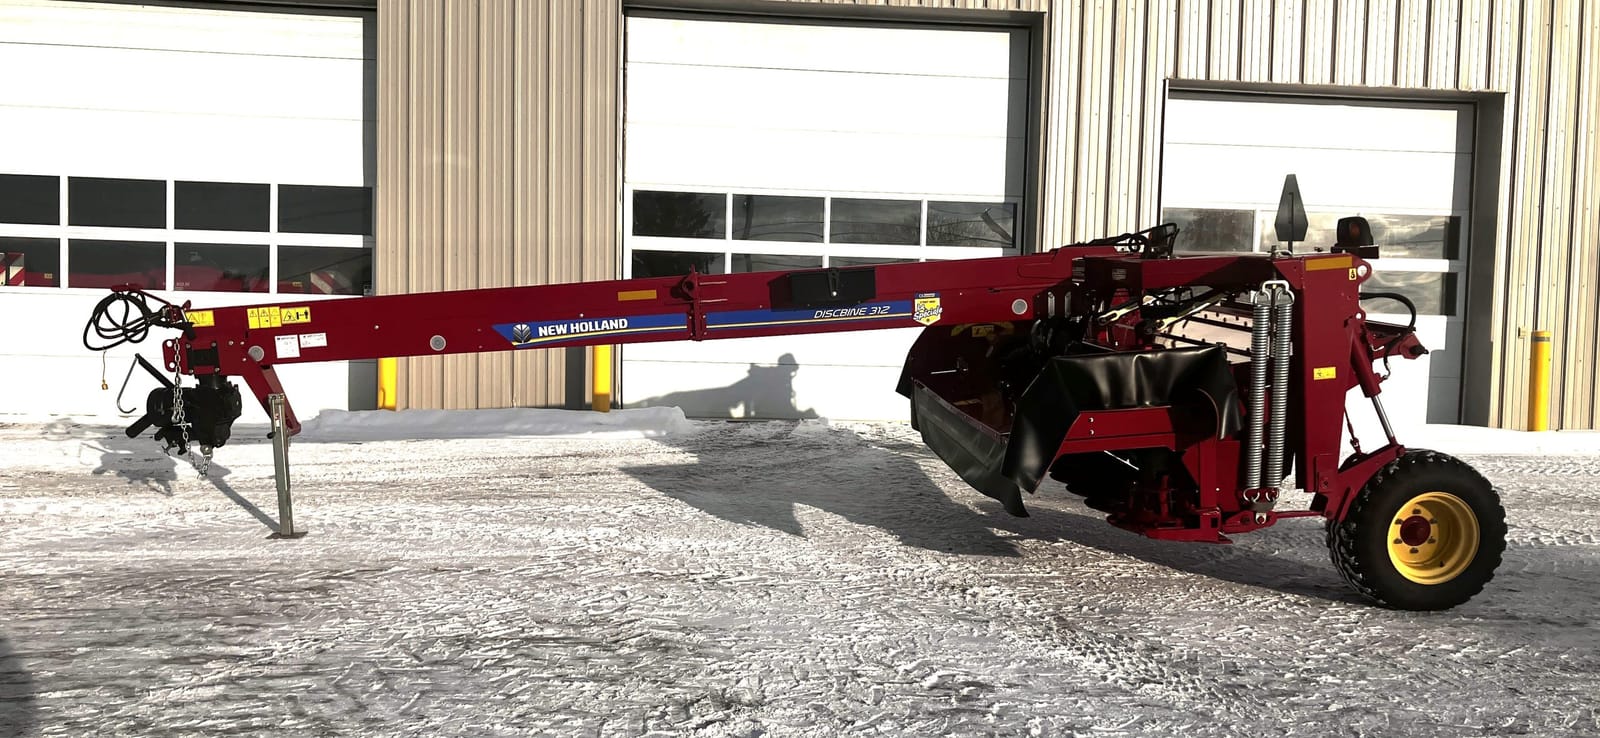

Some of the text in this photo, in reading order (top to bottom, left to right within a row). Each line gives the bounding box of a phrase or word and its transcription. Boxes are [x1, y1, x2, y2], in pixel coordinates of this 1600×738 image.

[814, 306, 890, 319] DISCBINE 312
[538, 318, 628, 337] NEW HOLLAND
